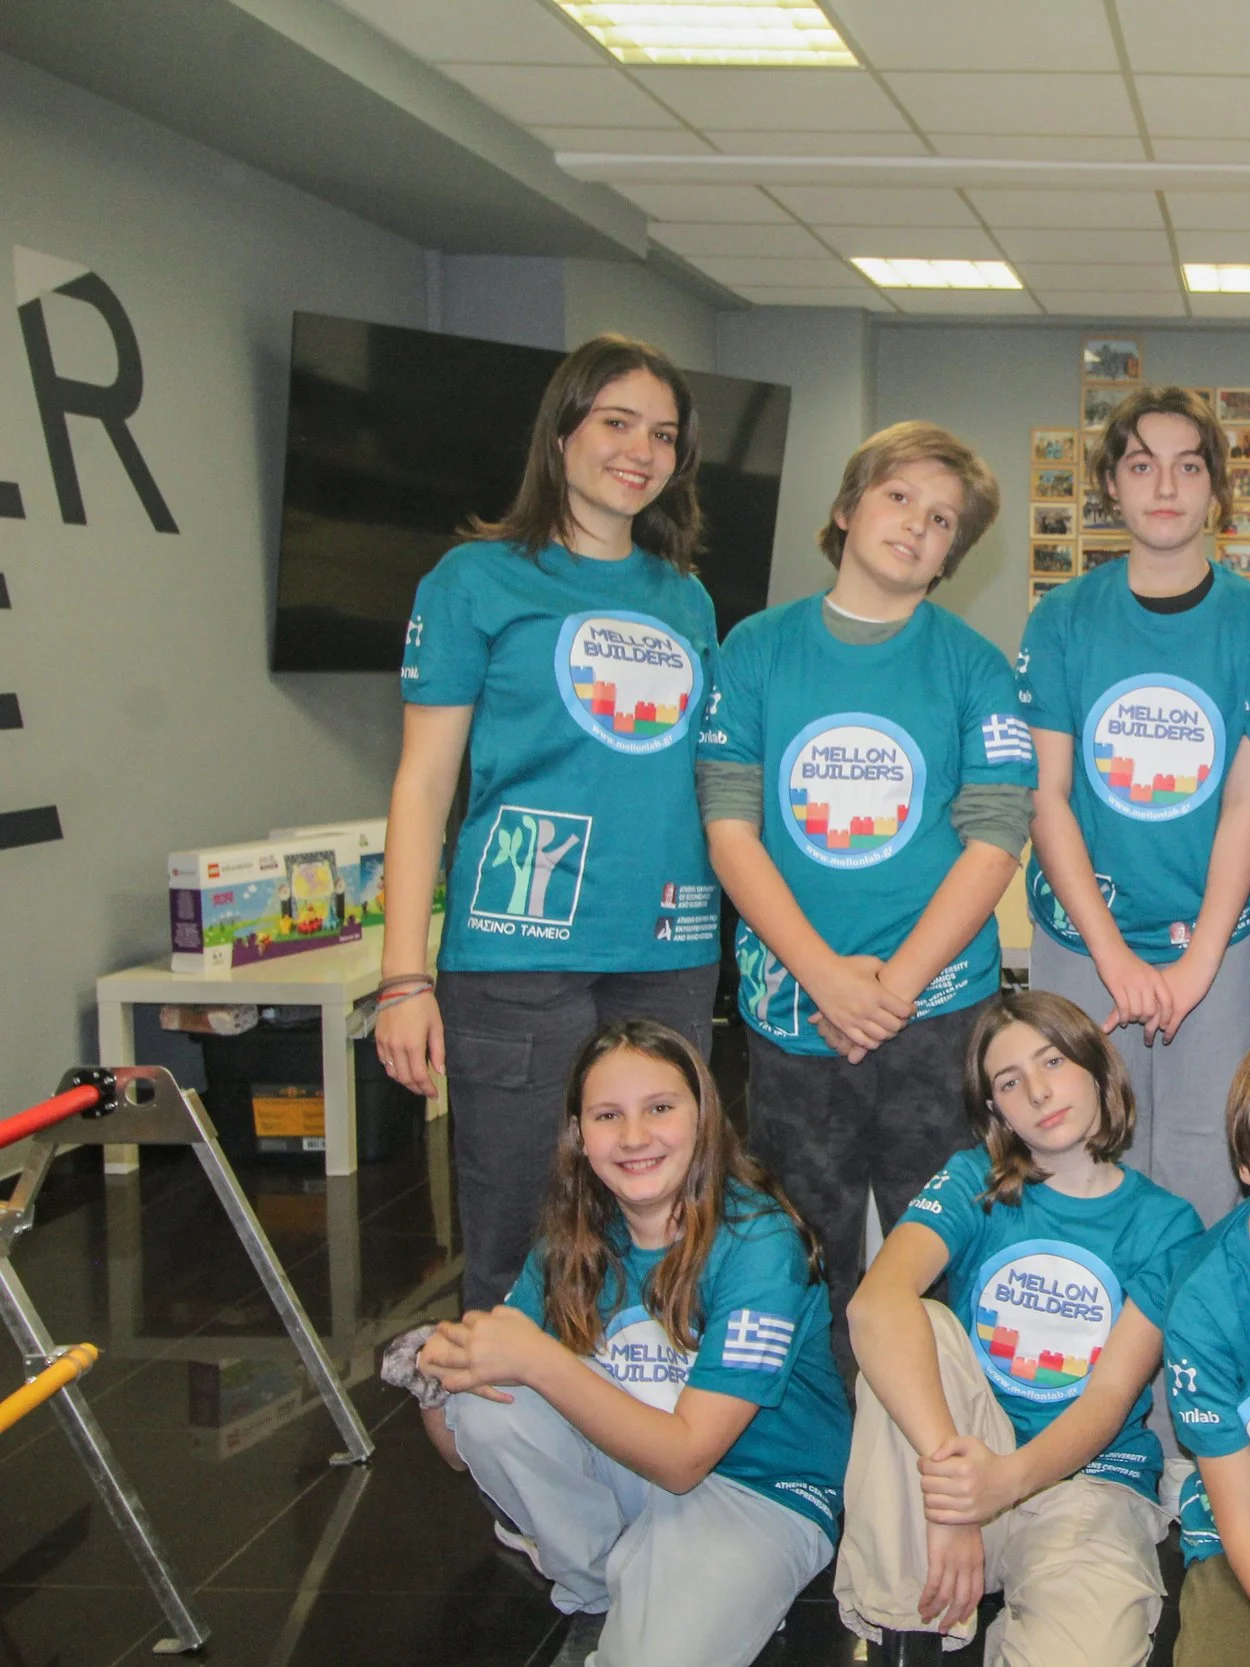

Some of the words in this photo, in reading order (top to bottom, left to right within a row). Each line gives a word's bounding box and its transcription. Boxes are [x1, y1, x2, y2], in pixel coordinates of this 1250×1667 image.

[0, 262, 180, 534] R
[589, 626, 672, 651] MELLON
[584, 641, 684, 669] BUILDERS
[1118, 704, 1199, 725] MELLON
[1108, 719, 1206, 742] BUILDERS
[811, 745, 896, 763] MELLON
[802, 764, 904, 781] BUILDERS
[805, 842, 894, 867] www.mellonlab.gr
[467, 916, 515, 936] ΠΡΑΣΙΝΟ
[521, 923, 570, 941] ΤΑΜΕΙΟ
[909, 1198, 943, 1214] nlab
[1008, 1268, 1098, 1303] MELLON
[995, 1284, 1104, 1323] BUILDERS
[611, 1343, 689, 1365] MELLON
[601, 1362, 689, 1385] UILDER
[986, 1363, 1079, 1402] www.mellonlab.gr
